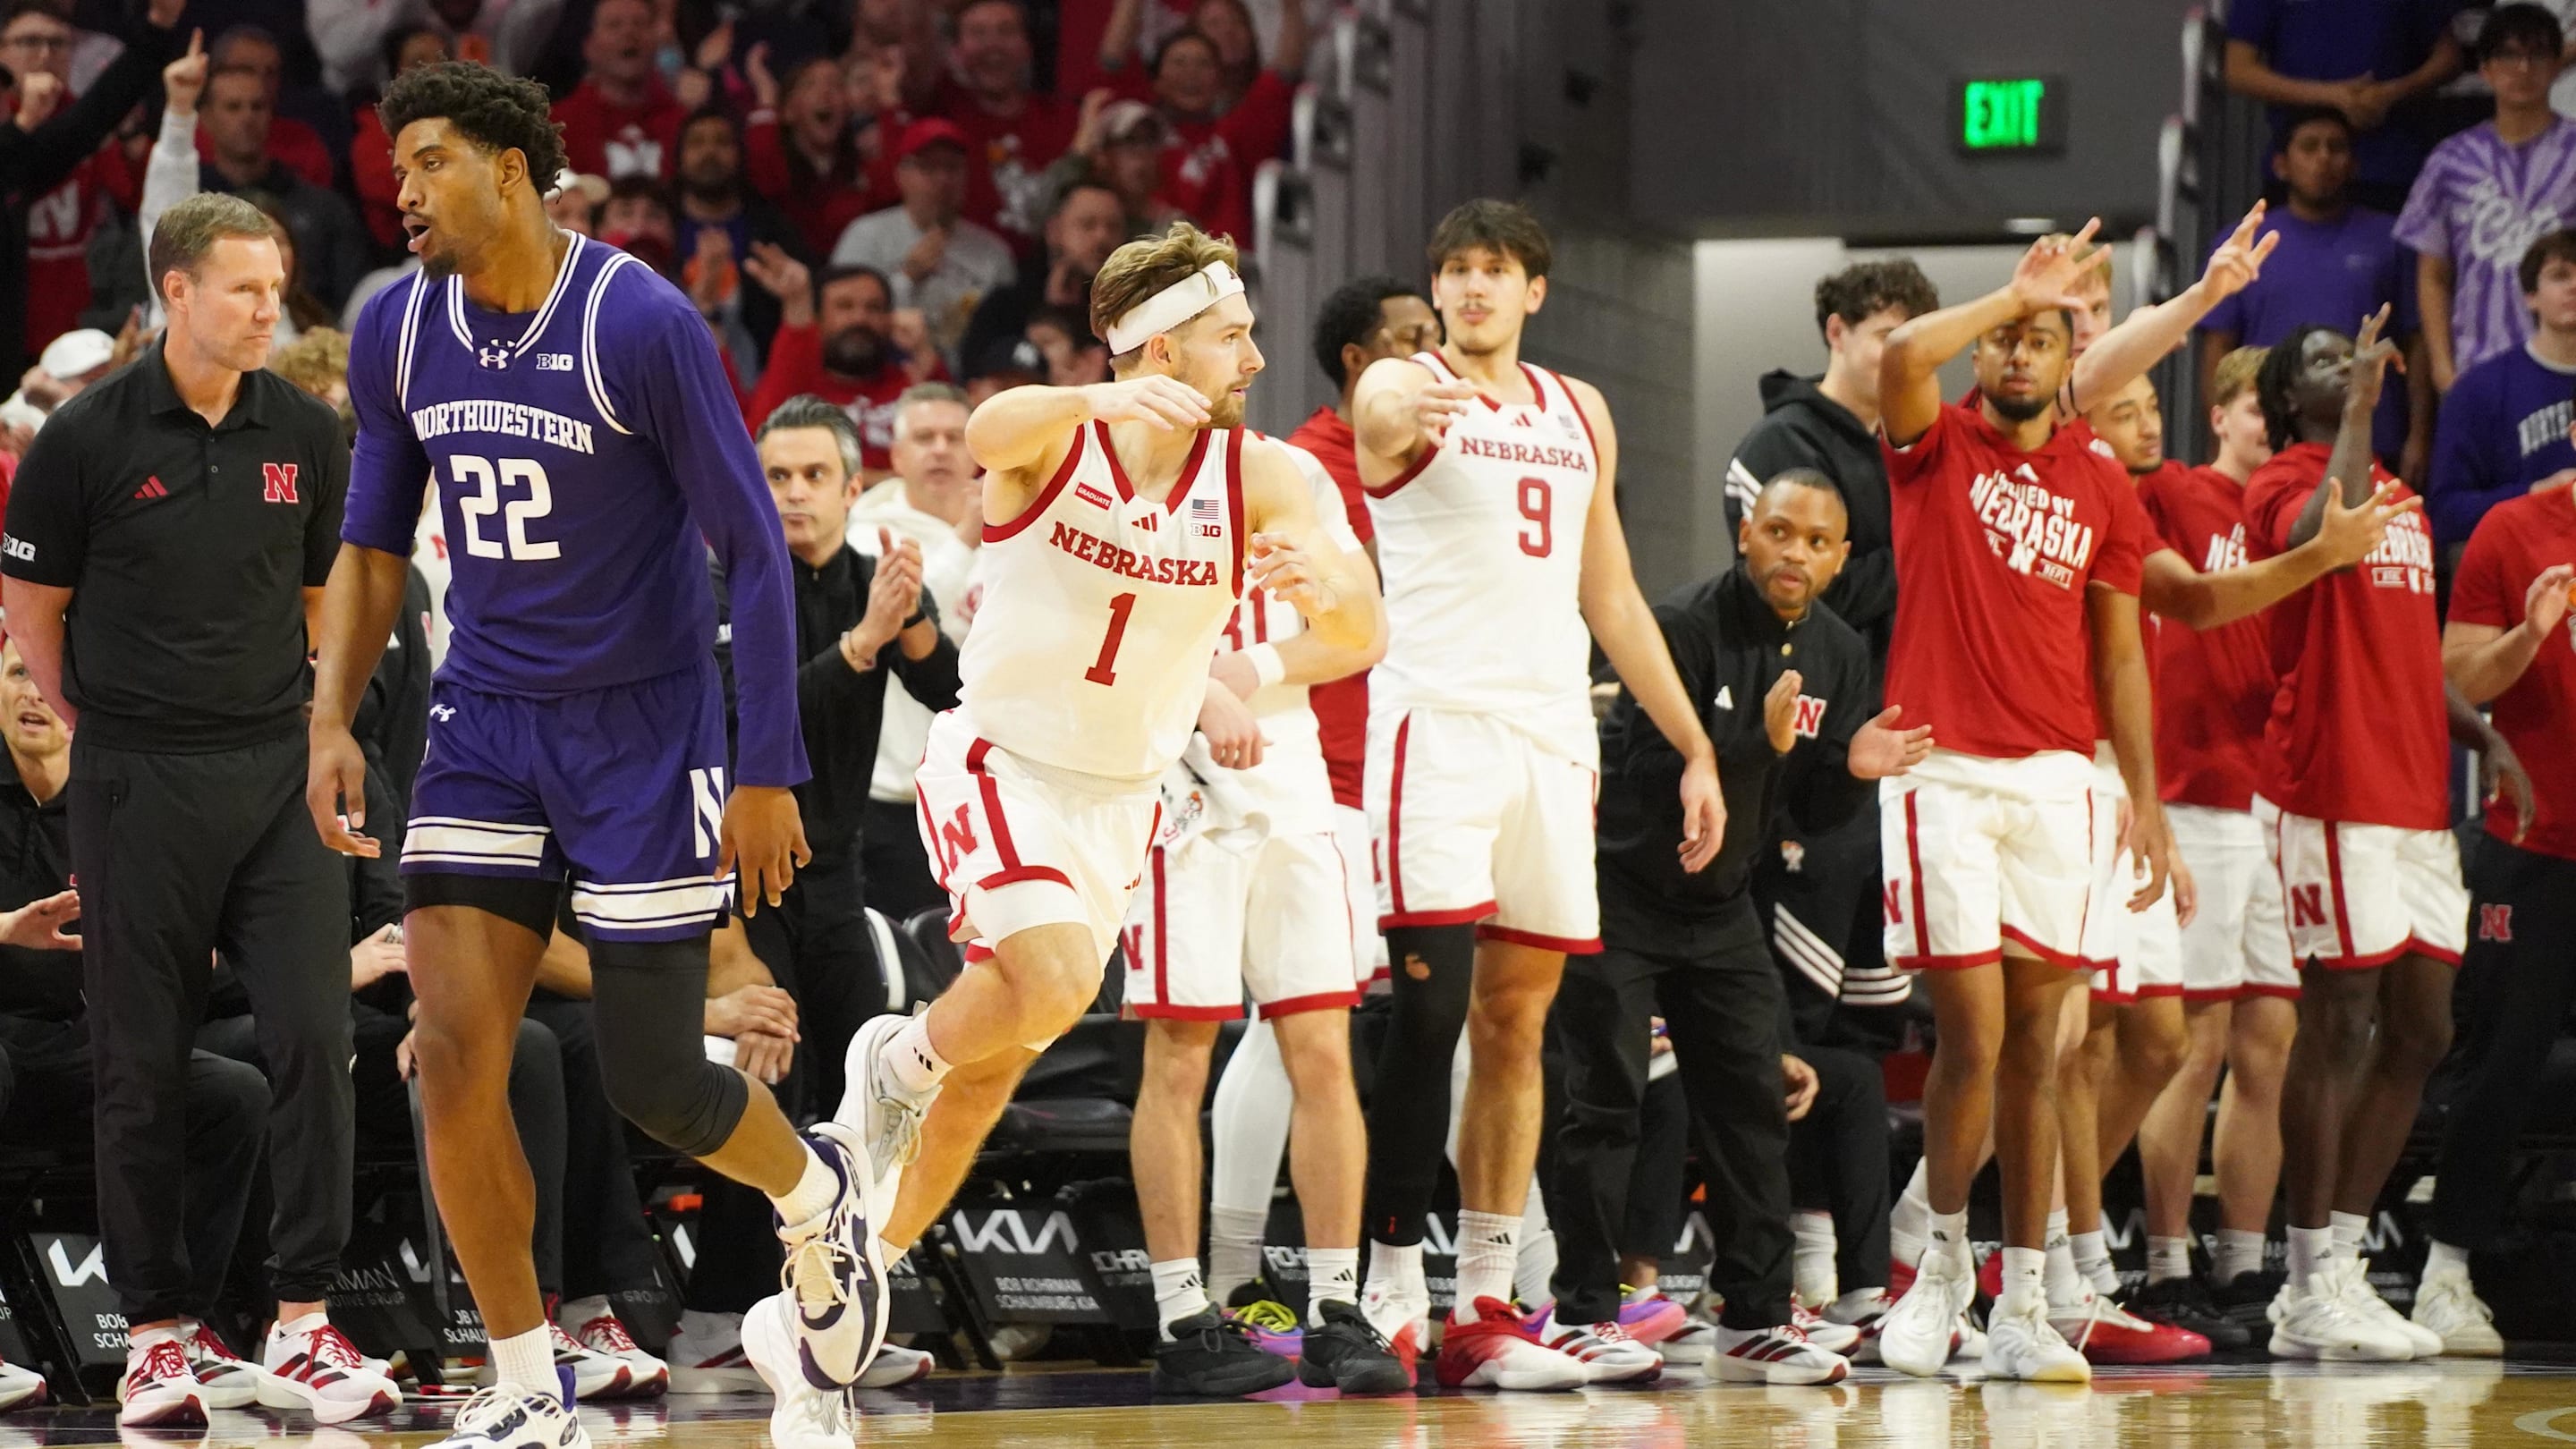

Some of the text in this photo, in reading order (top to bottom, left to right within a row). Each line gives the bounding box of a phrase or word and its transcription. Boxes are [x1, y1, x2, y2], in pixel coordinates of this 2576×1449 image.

[1965, 80, 2045, 148] EXIT
[536, 352, 574, 372] BIG
[411, 399, 595, 455] NORTHWESTERN
[1460, 436, 1589, 472] NEBRASKA
[263, 462, 299, 503] N
[1077, 486, 1112, 508] GRADUATE
[449, 454, 562, 562] 22
[1191, 522, 1222, 538] BIG
[1517, 476, 1552, 559] 9
[1970, 472, 2093, 570] NEBRASKA
[1048, 521, 1219, 587] NEBRASKA
[1084, 592, 1136, 687] 1
[1793, 694, 1827, 739] N
[689, 766, 724, 859] N
[942, 802, 978, 873] N
[2291, 883, 2326, 927] N
[2479, 902, 2512, 943] N
[95, 1313, 130, 1329] BOB
